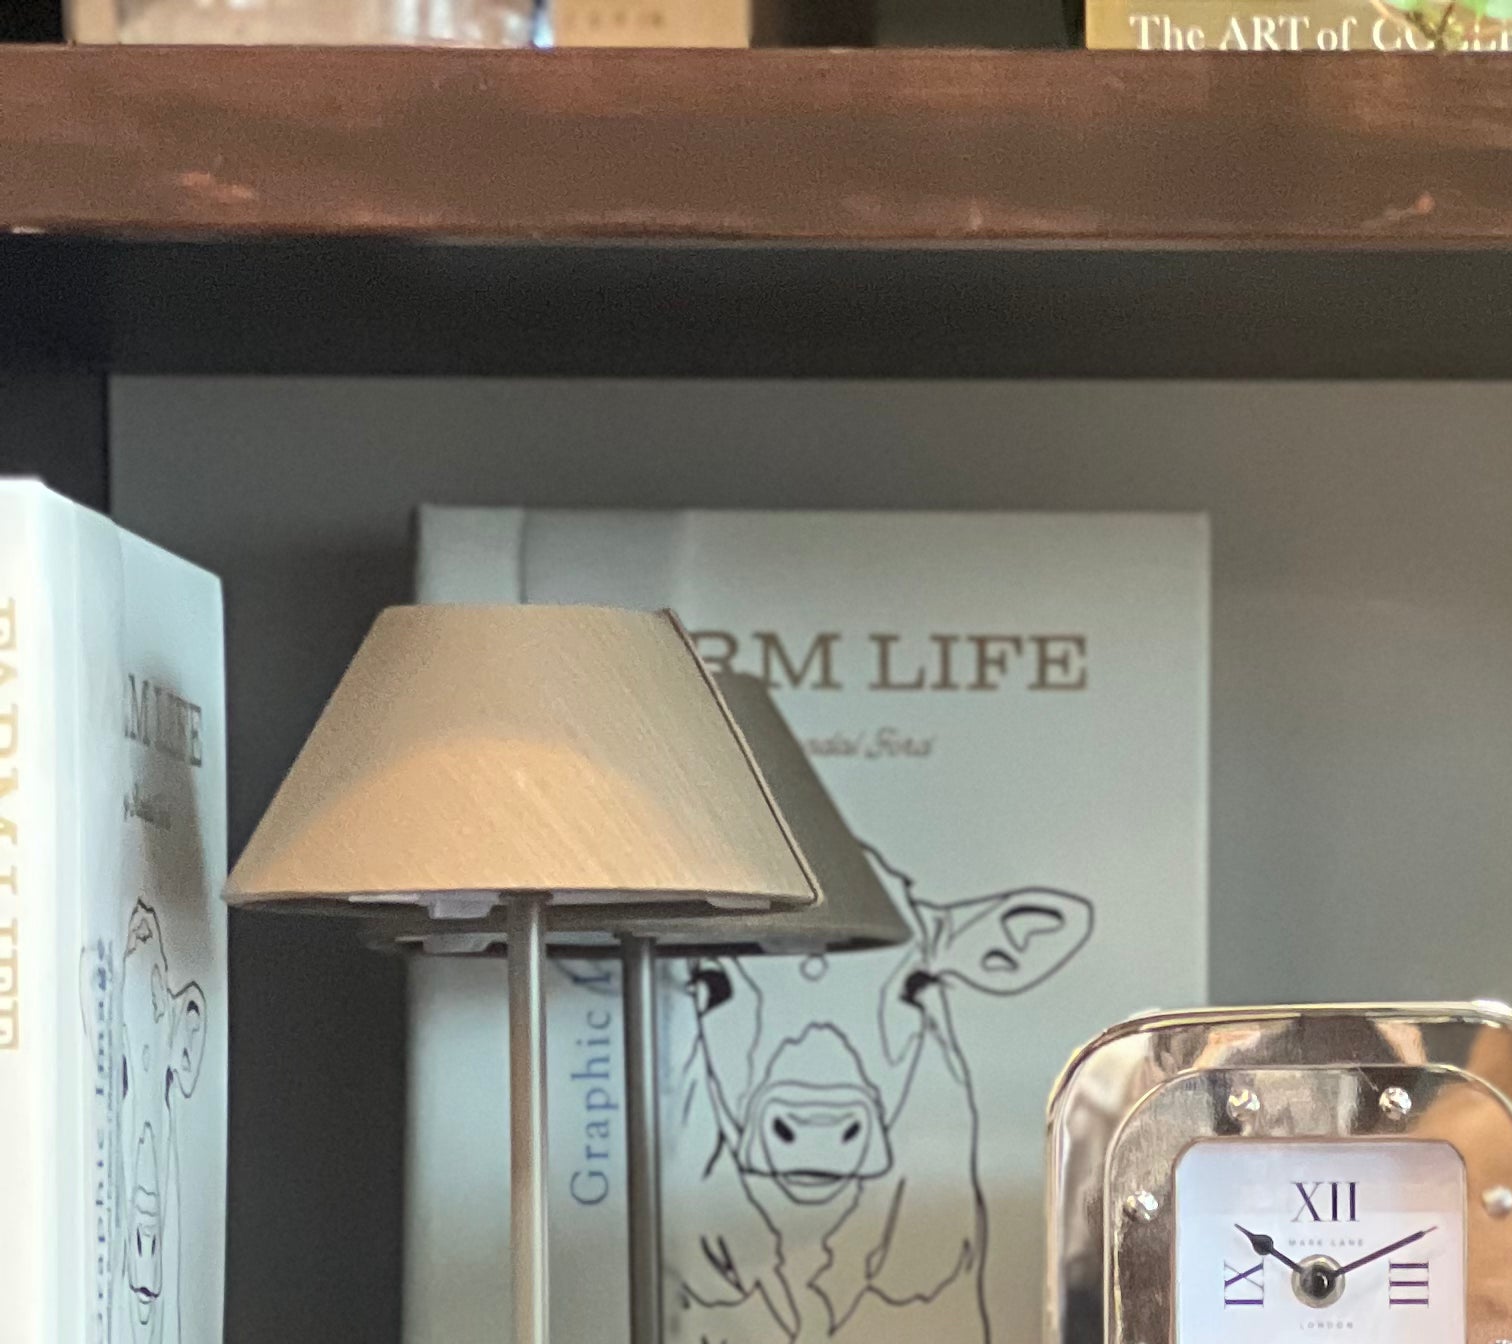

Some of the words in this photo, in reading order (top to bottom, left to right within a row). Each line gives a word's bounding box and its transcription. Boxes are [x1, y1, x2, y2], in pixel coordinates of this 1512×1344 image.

[1129, 15, 1205, 51] The
[1219, 15, 1311, 51] ART
[1316, 14, 1357, 51] of
[869, 633, 1088, 692] LIFE
[569, 1009, 620, 1207] Graphic
[1290, 1181, 1361, 1222] XII
[1288, 1238, 1324, 1248] MARK
[1330, 1238, 1365, 1248] LANE
[1388, 1258, 1430, 1309] III
